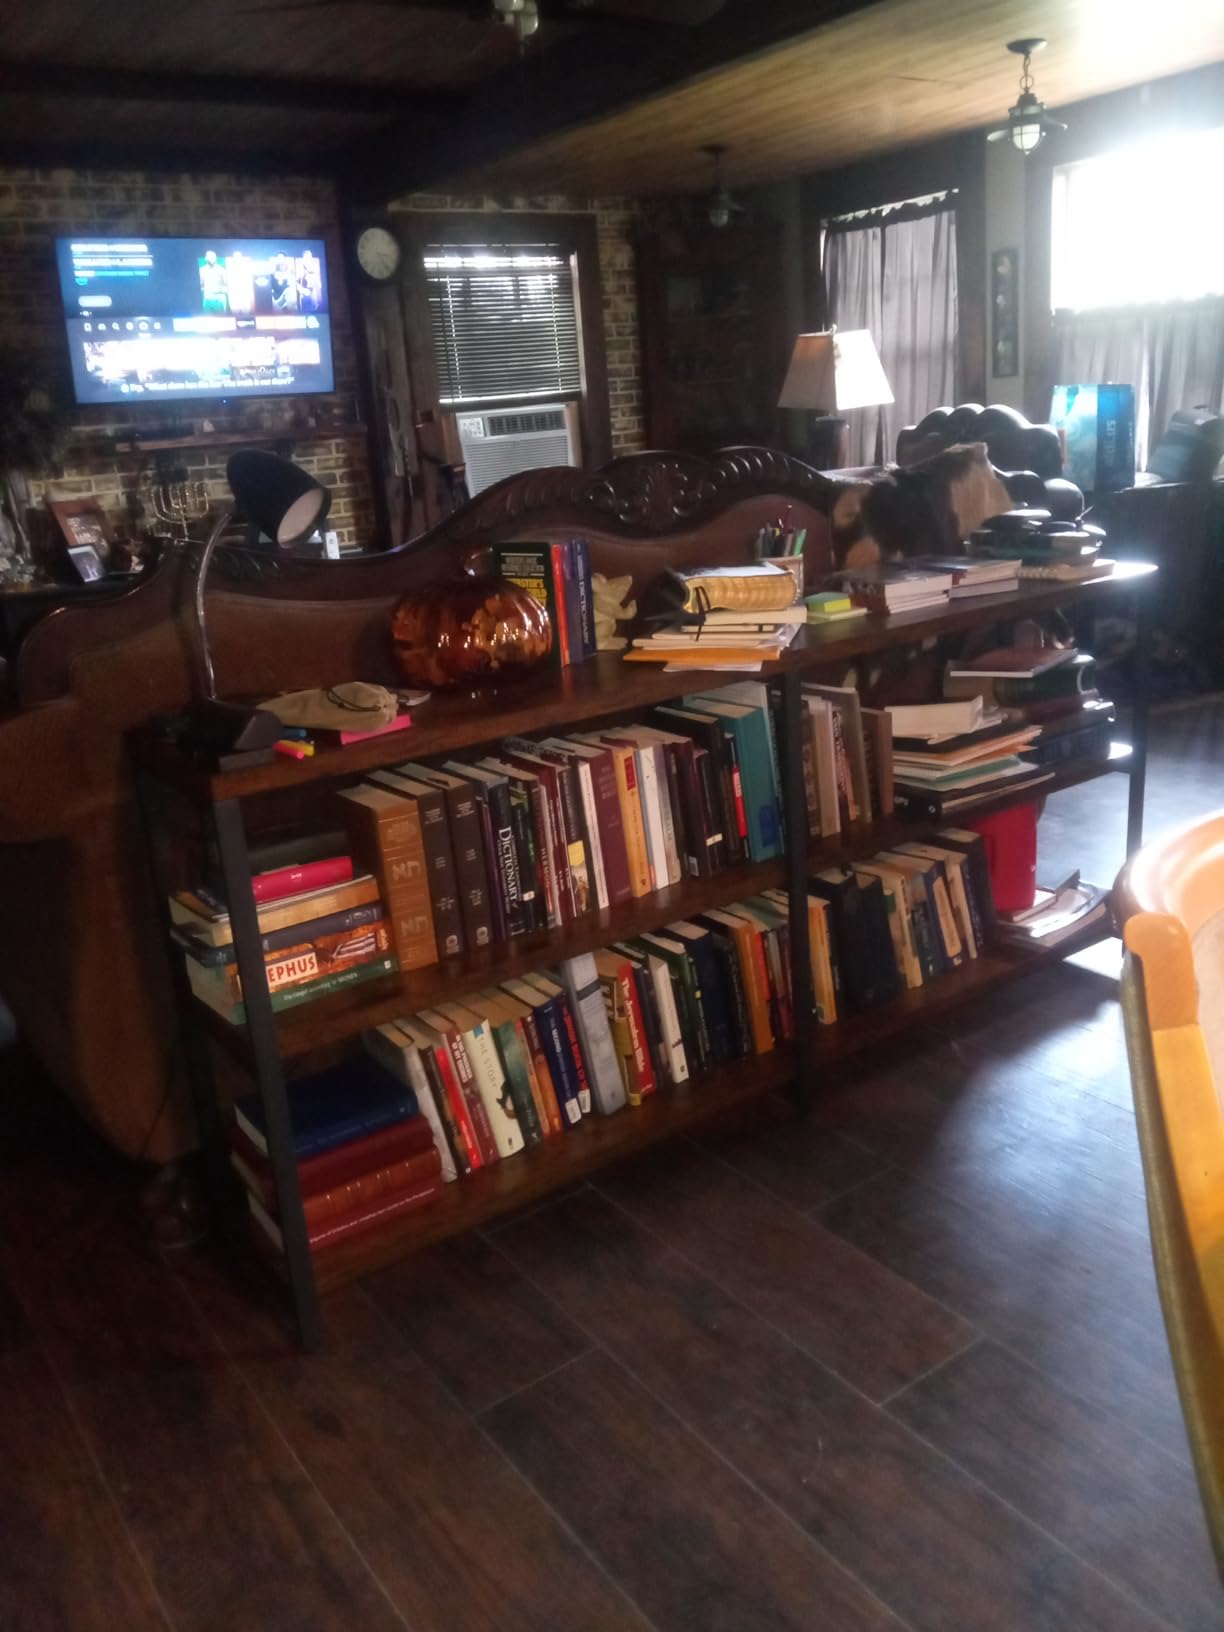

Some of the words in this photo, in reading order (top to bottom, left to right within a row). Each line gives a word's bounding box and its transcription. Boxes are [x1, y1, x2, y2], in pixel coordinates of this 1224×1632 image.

[499, 827, 518, 900] DICTIONARY
[268, 956, 315, 982] EPHUS
[622, 977, 630, 998] The
[477, 1036, 488, 1055] THE
[484, 1059, 497, 1087] STORY
